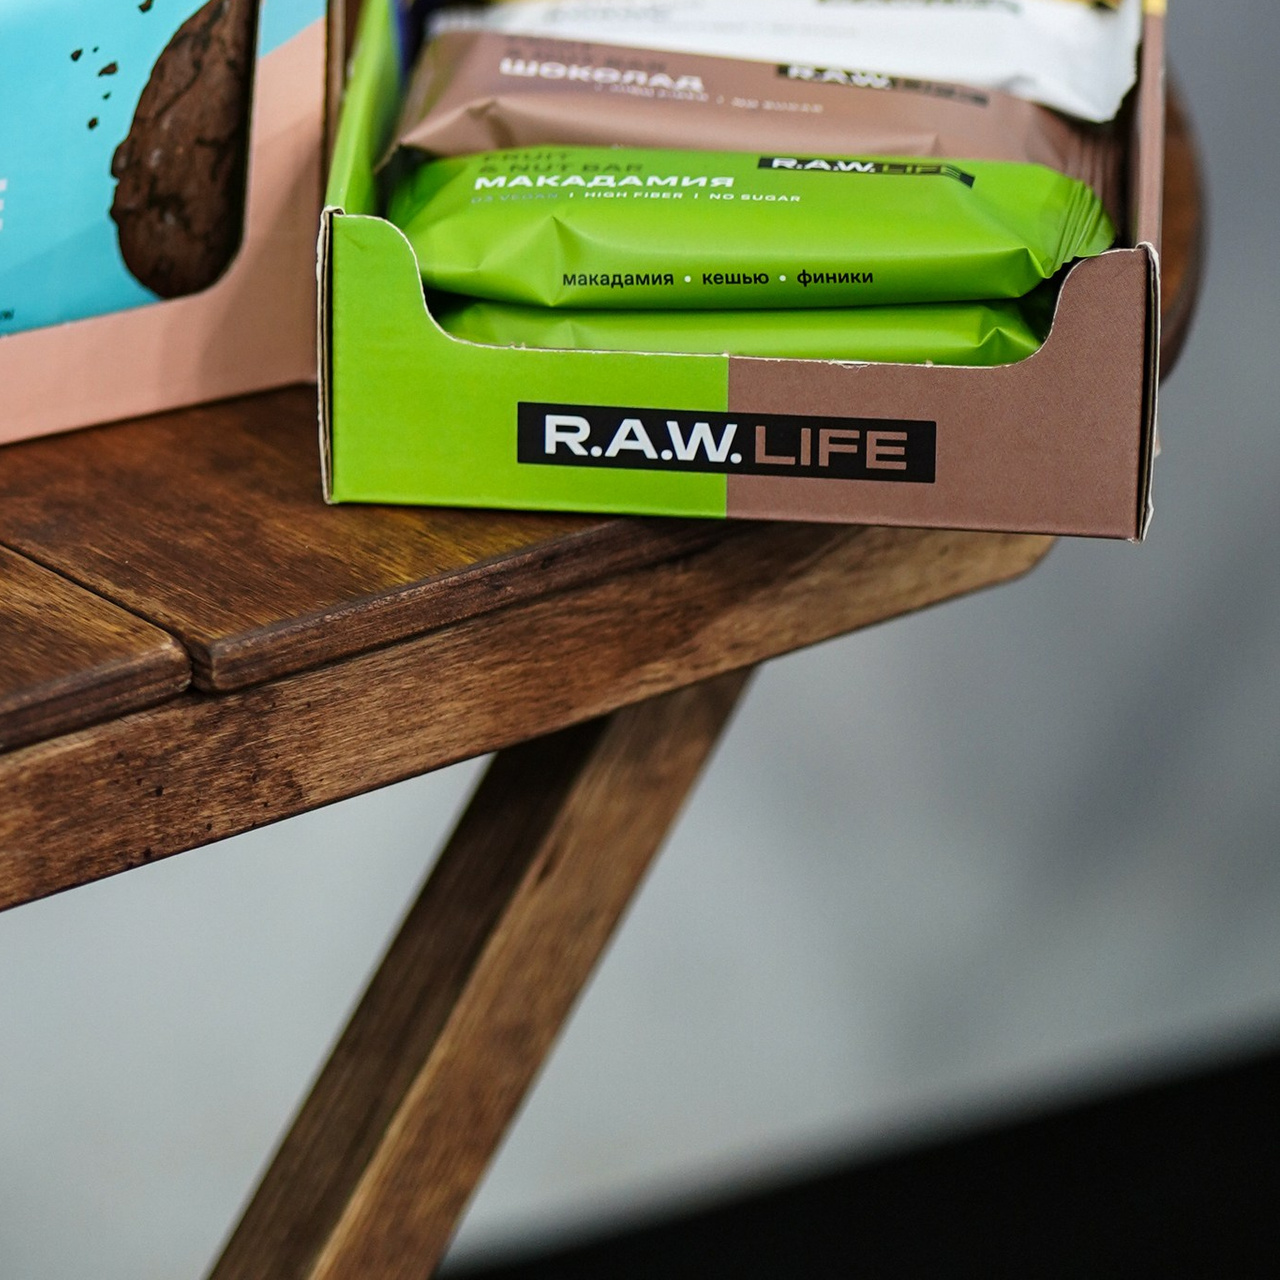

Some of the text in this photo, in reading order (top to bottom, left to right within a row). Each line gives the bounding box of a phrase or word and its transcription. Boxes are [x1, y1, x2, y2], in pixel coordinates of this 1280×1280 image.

[500, 57, 704, 93] ШОКОЛАД
[475, 175, 734, 190] МАКАДАМИЯ
[740, 194, 801, 202] SUGAR
[563, 269, 873, 288] макадамия кешью финики
[755, 426, 907, 470] LIFE
